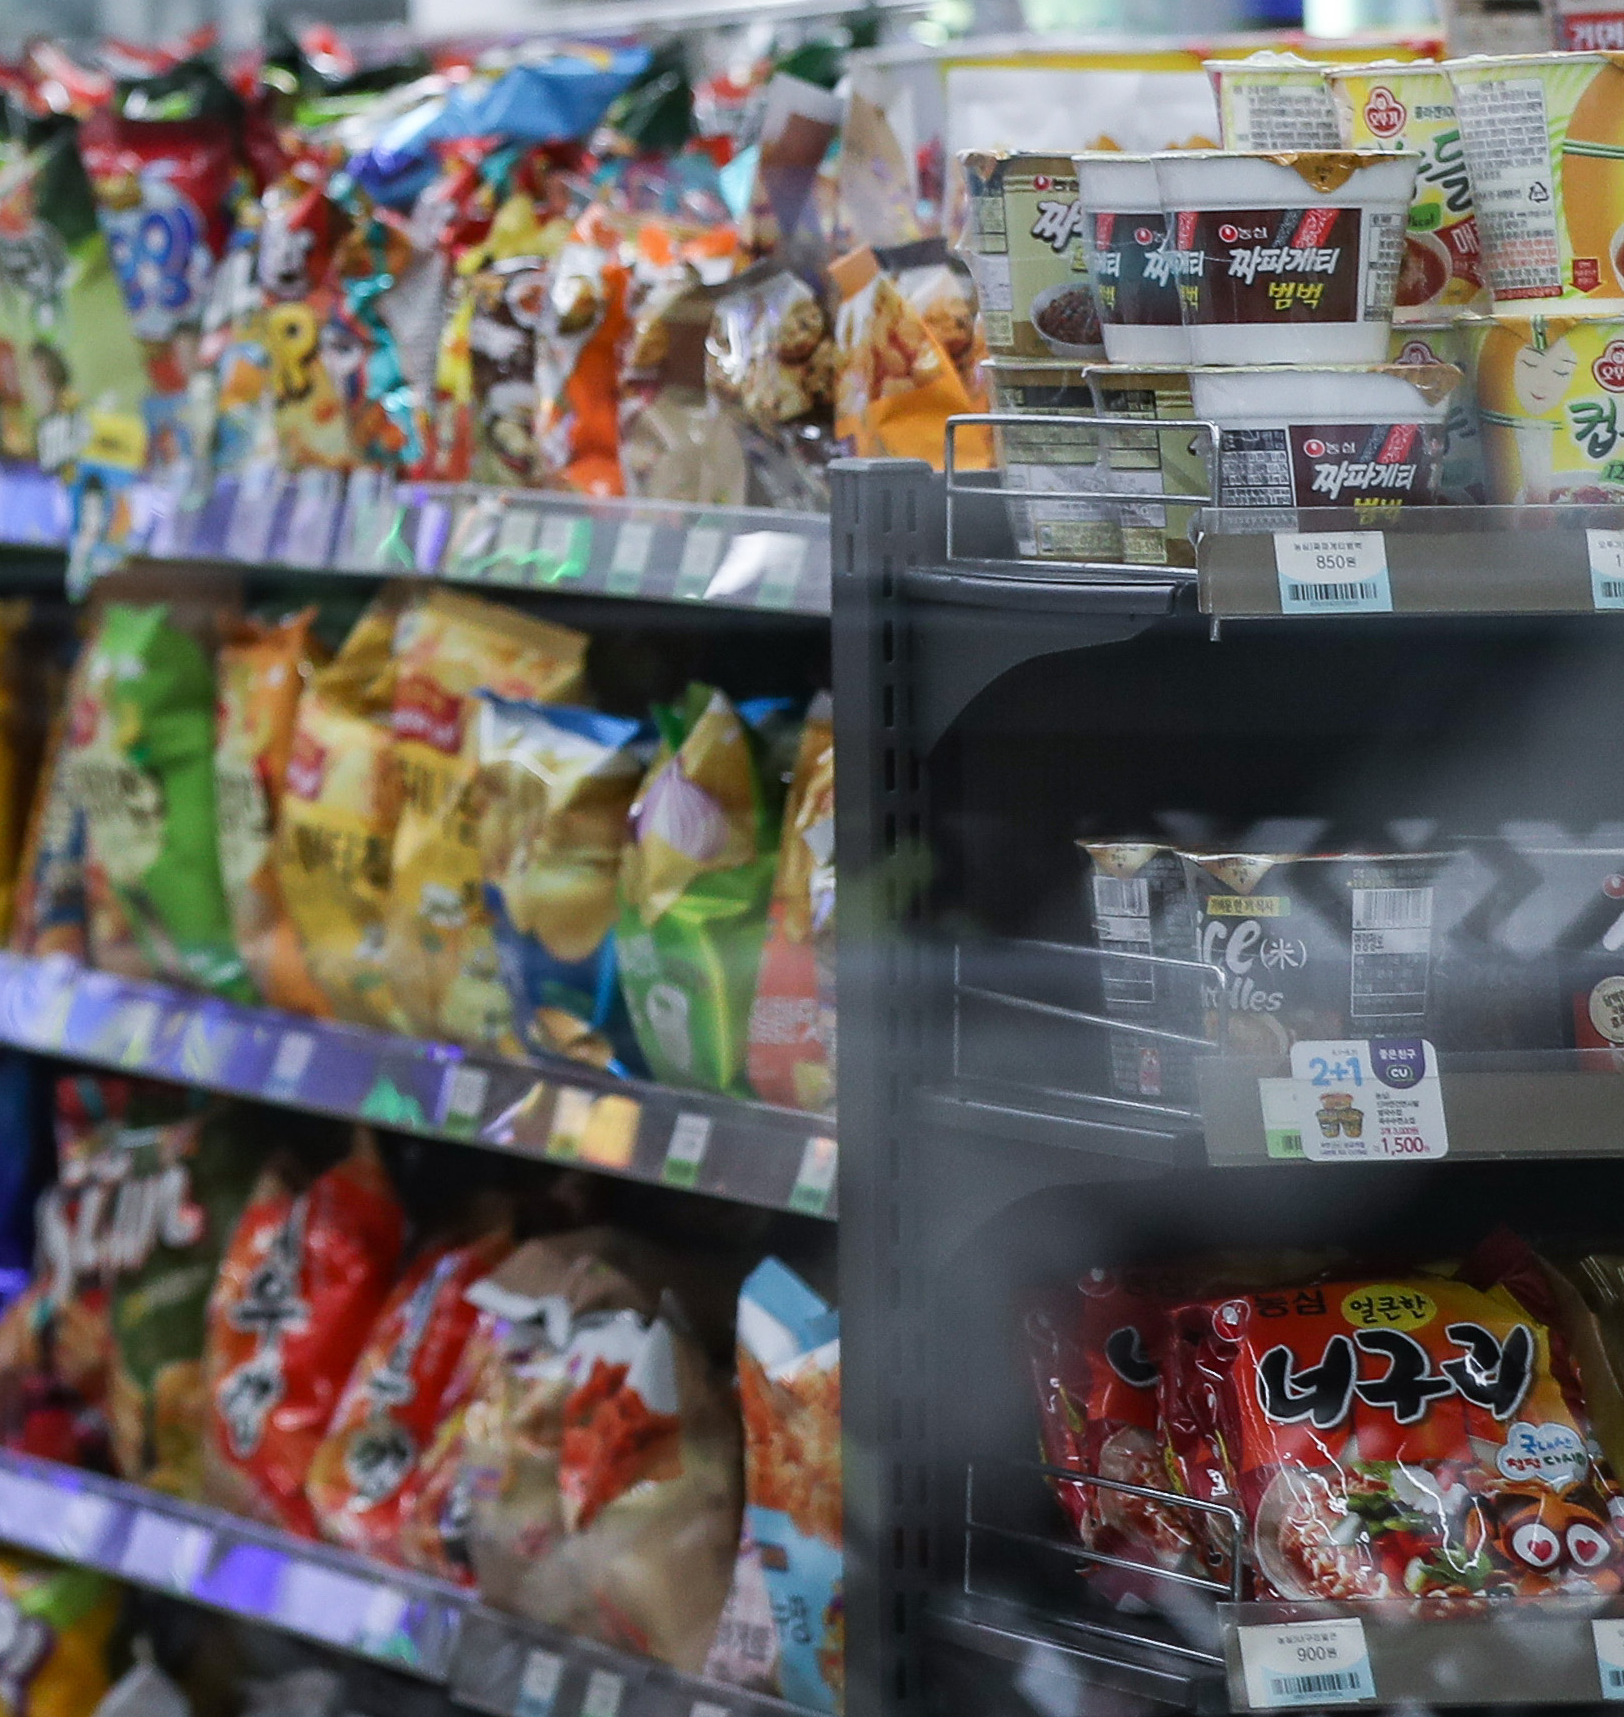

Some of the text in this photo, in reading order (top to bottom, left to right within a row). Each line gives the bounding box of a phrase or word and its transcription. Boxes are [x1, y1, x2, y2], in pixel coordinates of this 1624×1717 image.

[1238, 225, 1267, 241] 농심
[1227, 245, 1341, 285] 짜파게티
[1269, 281, 1324, 310] 범벅
[1326, 440, 1356, 455] 농심
[1311, 462, 1417, 500] 짜파게티
[1316, 554, 1357, 570] 850원
[1309, 1056, 1363, 1087] 2+1
[1390, 1068, 1409, 1078] CU
[1255, 1288, 1328, 1318] 농심
[1348, 1293, 1432, 1323] 얼큰한
[1255, 1322, 1535, 1429] 너구리
[1296, 1646, 1338, 1662] 900원
